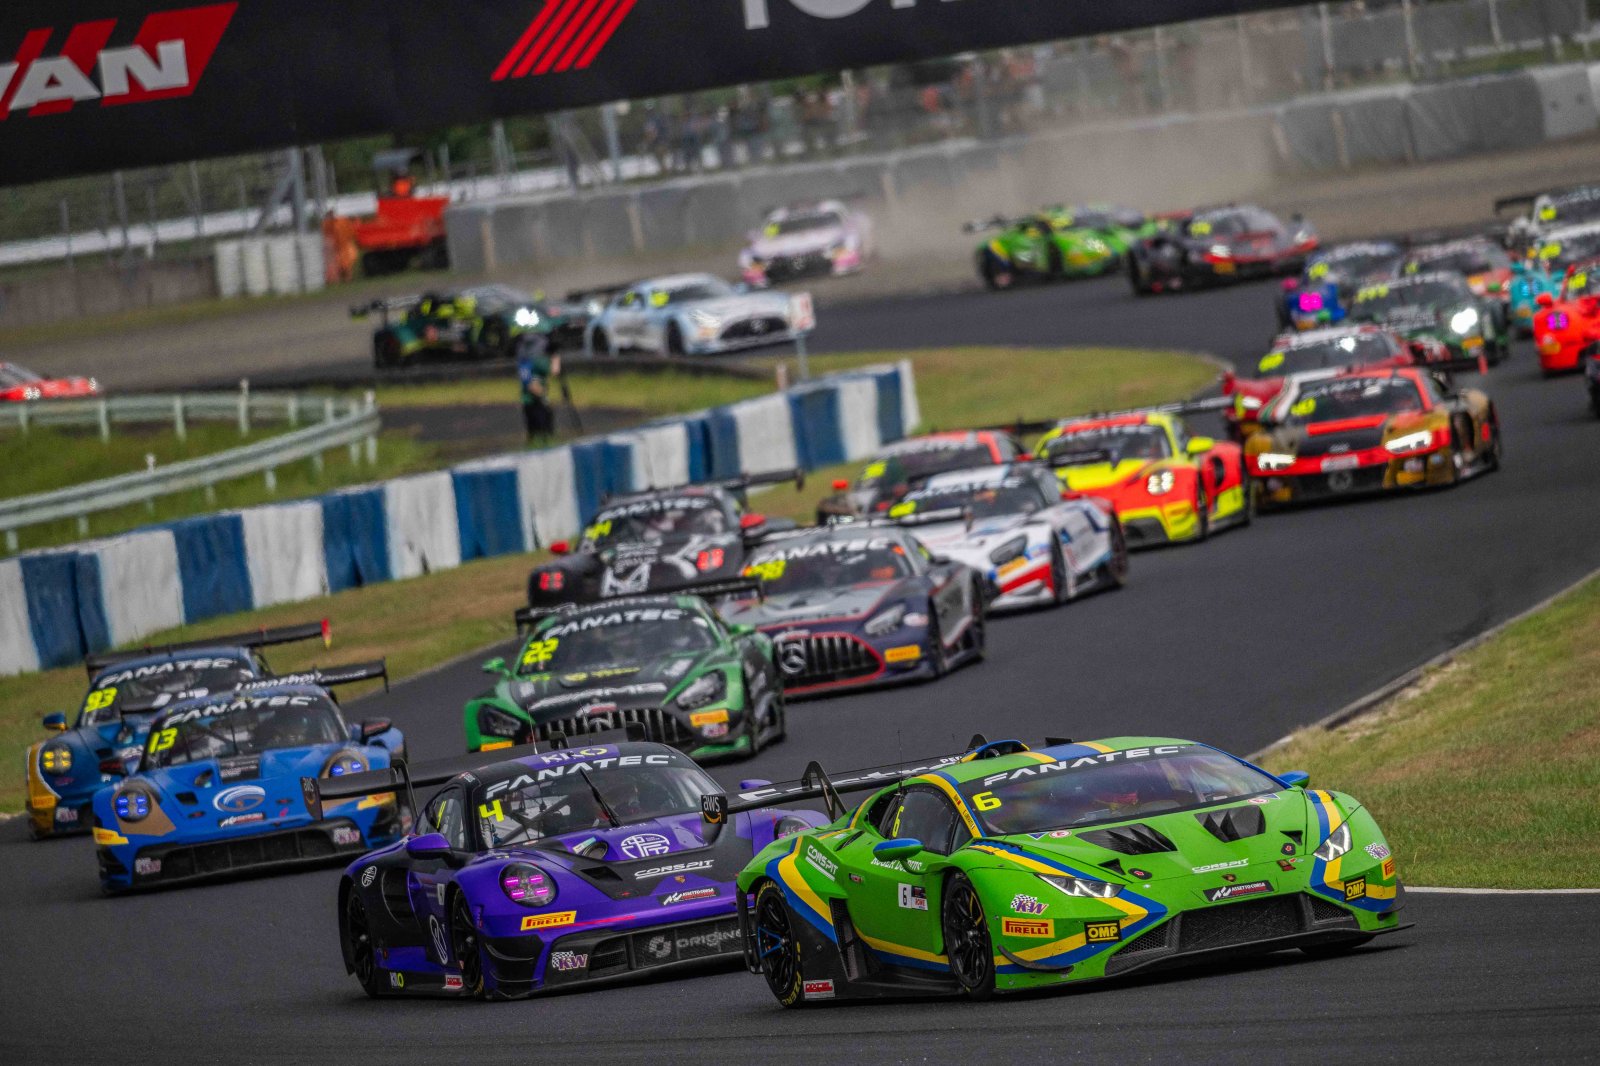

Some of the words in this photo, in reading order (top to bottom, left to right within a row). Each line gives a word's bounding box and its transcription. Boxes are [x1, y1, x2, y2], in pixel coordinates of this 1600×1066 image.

[541, 608, 683, 641] FANATEC
[523, 637, 560, 666] 22
[98, 657, 235, 689] FANATEC
[84, 687, 118, 713] 93
[162, 696, 312, 729] FANATEC
[149, 727, 178, 754] 13
[485, 753, 670, 801] FANATEC
[983, 746, 1180, 787] FANATEC
[479, 799, 505, 822] 4
[702, 795, 721, 813] aws
[972, 791, 1002, 812] 6
[634, 859, 715, 878] CONSPIT
[1346, 882, 1365, 897] OMP
[526, 914, 571, 928] PIRELLI
[1005, 920, 1049, 935] PIRELLI
[1087, 926, 1118, 938] OMP
